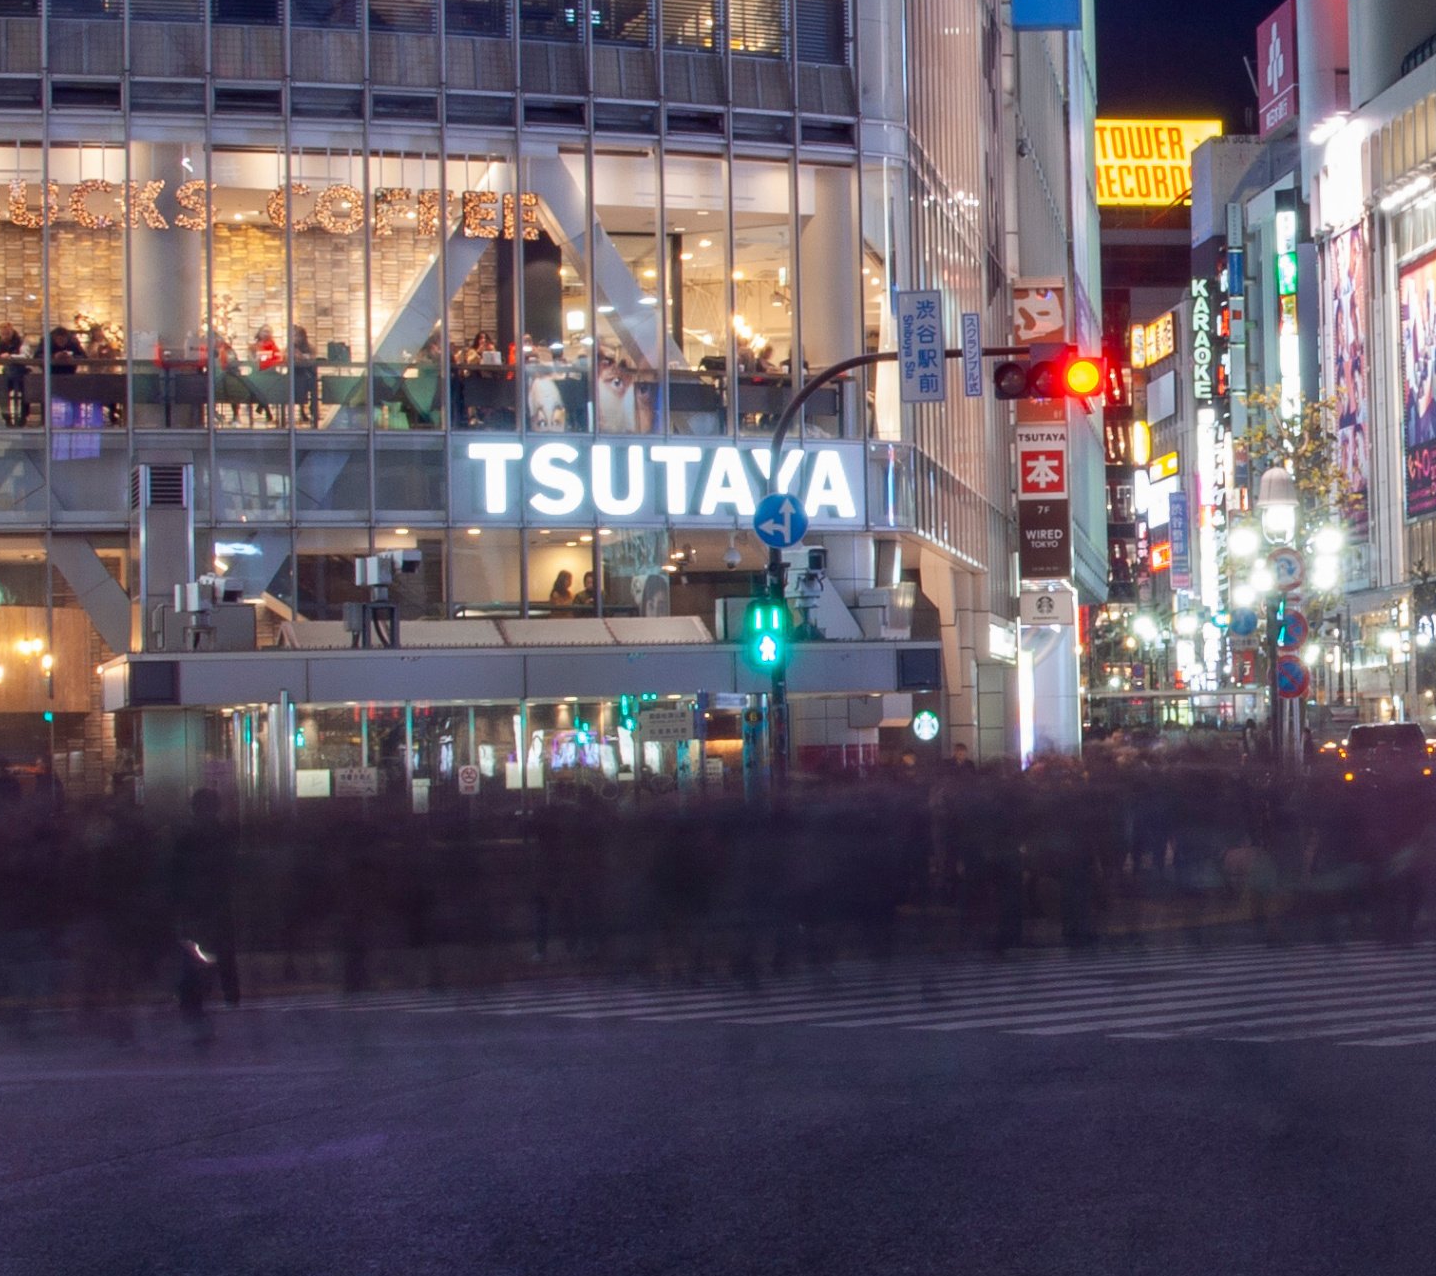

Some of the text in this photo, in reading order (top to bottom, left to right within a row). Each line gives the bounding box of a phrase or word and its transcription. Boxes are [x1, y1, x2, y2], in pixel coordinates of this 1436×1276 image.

[1095, 126, 1185, 160] TOWER
[1096, 165, 1192, 198] RECORD
[916, 299, 939, 393] 渋谷駅前
[1191, 279, 1212, 399] KARAOKE
[1018, 434, 1066, 442] TSUTAYA
[468, 442, 856, 517] TSUTAYA
[1026, 455, 1060, 489] 本
[1037, 506, 1050, 514] 7F
[1026, 529, 1063, 540] WIRED
